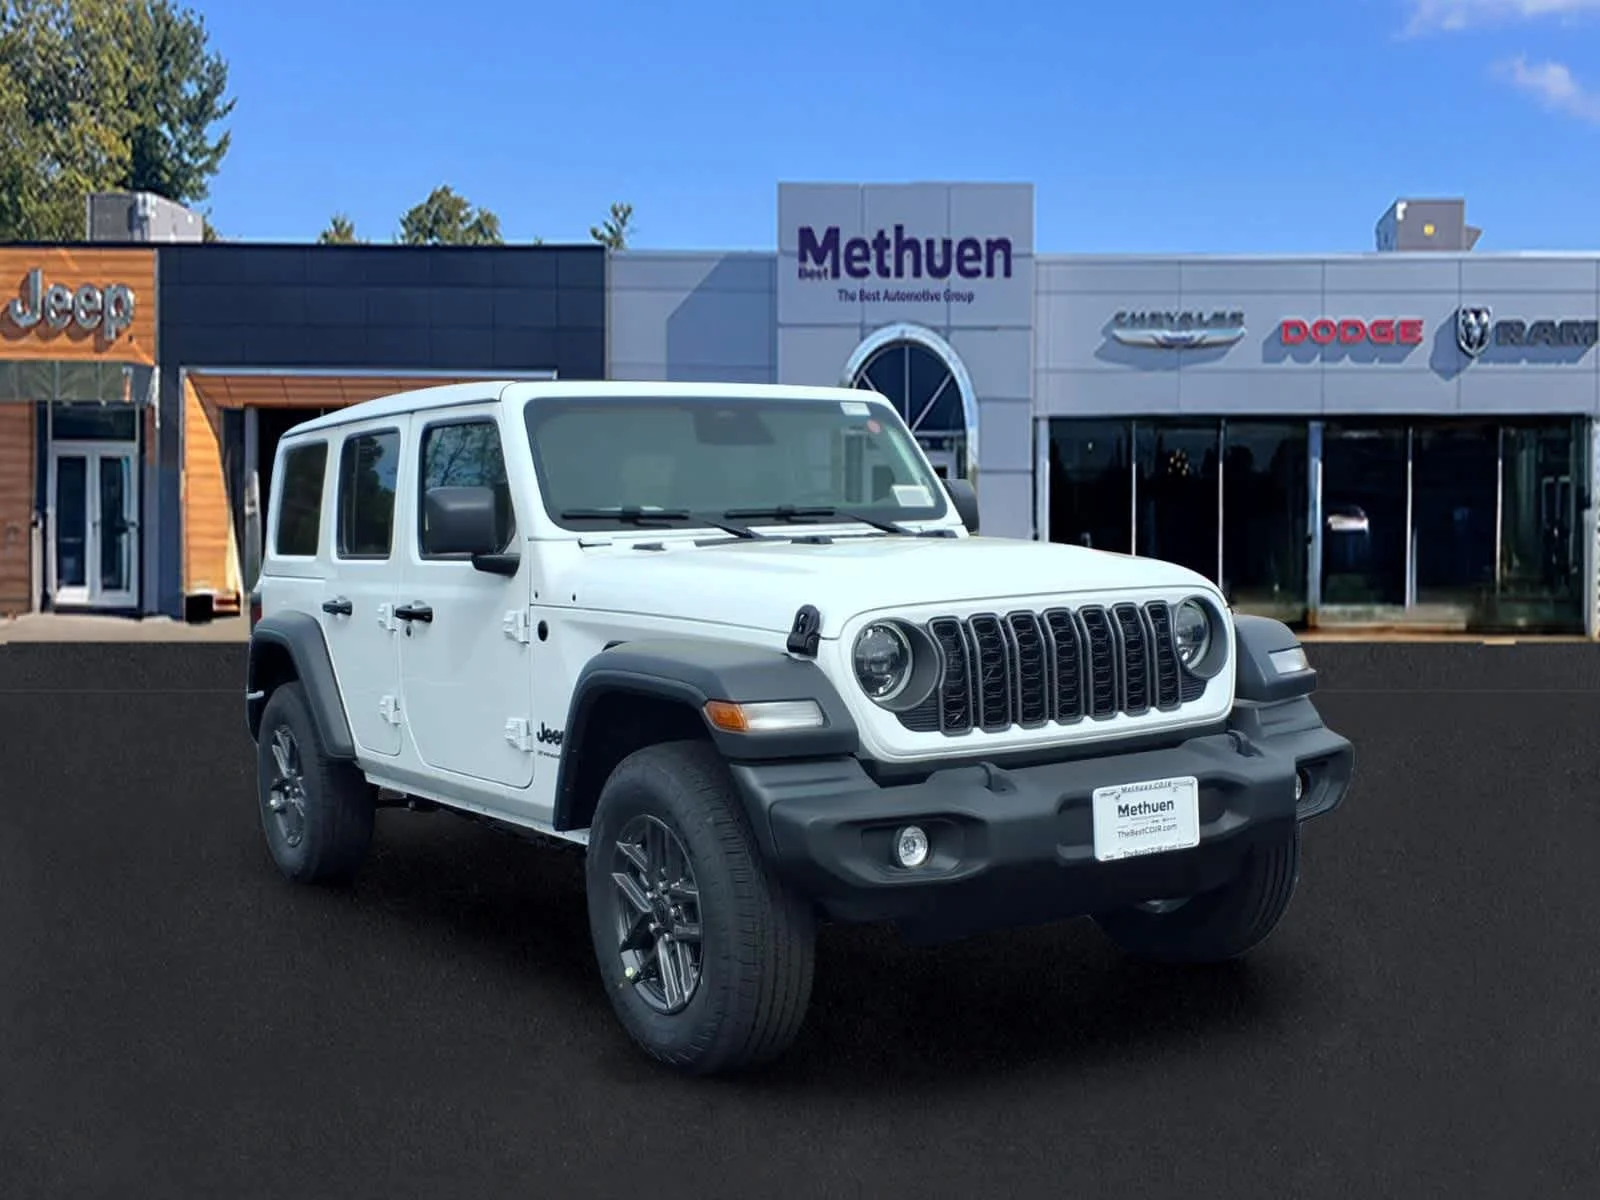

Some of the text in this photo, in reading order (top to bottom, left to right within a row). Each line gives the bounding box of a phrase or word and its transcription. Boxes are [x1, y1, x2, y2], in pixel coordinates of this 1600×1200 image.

[798, 224, 1012, 279] Methuen
[8, 268, 135, 340] Jeep
[838, 289, 974, 304] The Best Automotive Group
[1281, 319, 1424, 345] DODGE
[1495, 320, 1598, 346] RAM
[1118, 800, 1174, 816] Methuen
